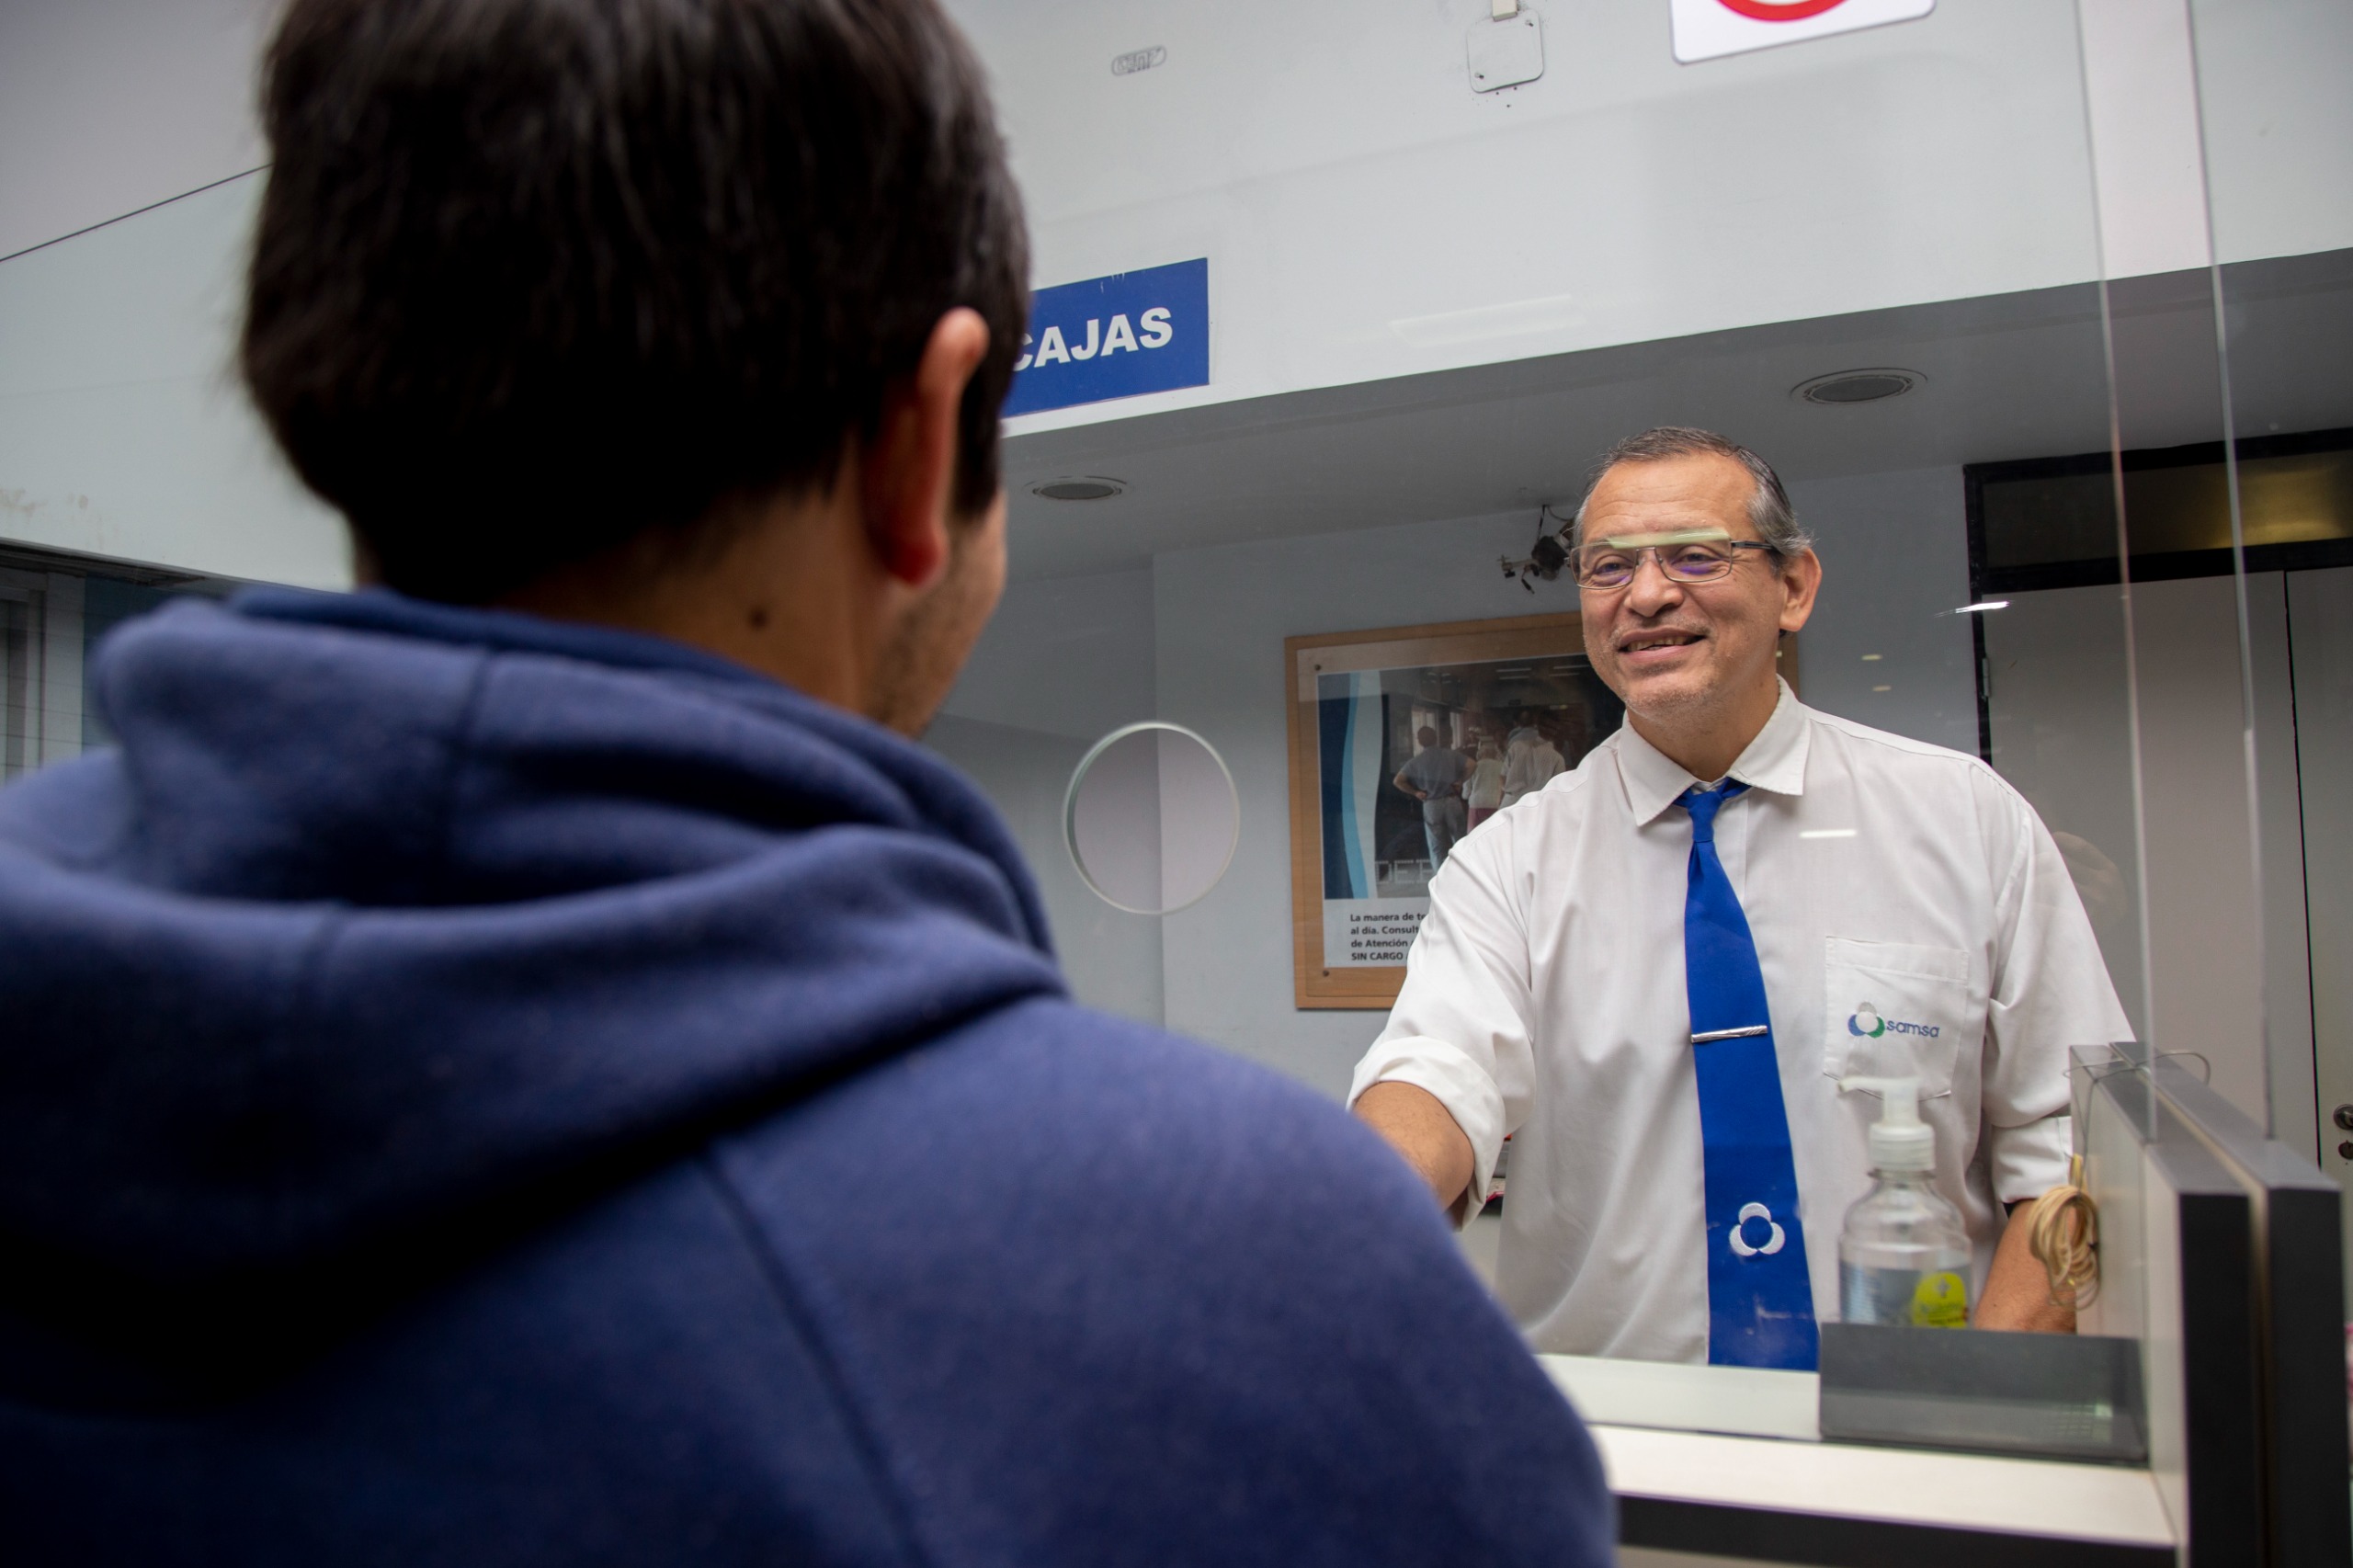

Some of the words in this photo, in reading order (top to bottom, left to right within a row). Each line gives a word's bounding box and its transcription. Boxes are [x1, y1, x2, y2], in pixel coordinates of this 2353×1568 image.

[1402, 913, 1414, 921] de
[1350, 926, 1359, 935] al
[1362, 926, 1379, 935] día.
[1350, 939, 1362, 948] de
[1365, 938, 1408, 948] Atención
[1351, 952, 1367, 960] SIN
[1370, 951, 1404, 960] CARGO
[1886, 1020, 1939, 1038] samsa
